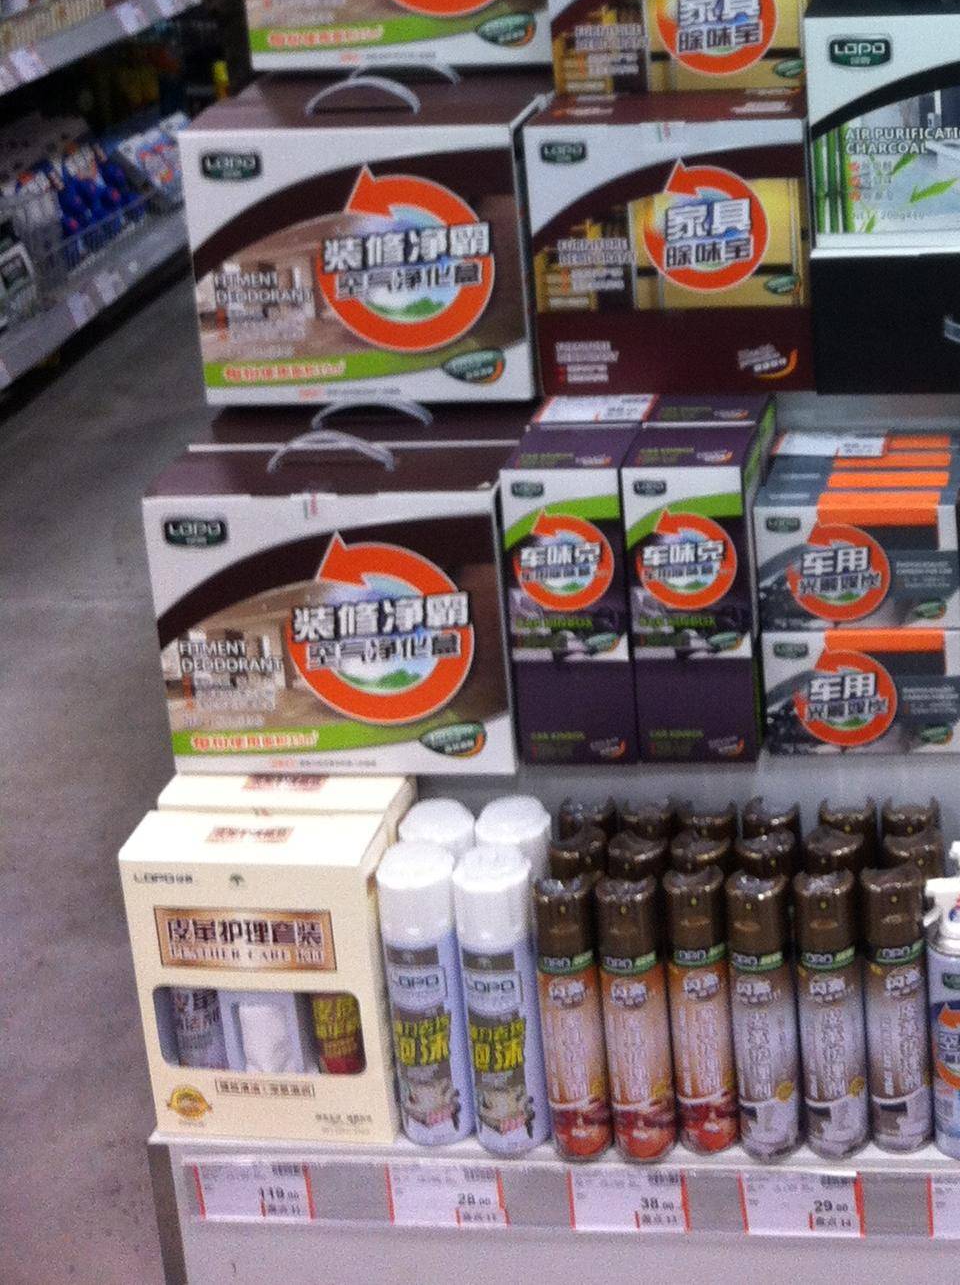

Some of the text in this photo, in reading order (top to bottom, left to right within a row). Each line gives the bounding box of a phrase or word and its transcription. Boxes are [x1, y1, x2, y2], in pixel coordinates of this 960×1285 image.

[677, 22, 762, 54] 除味宝
[834, 41, 886, 56] LOPO
[845, 128, 871, 141] AIR
[845, 142, 928, 155] CHARCOAL
[666, 199, 751, 239] 家具
[665, 237, 753, 268] 除味宝
[643, 540, 726, 567] 车味克
[803, 547, 869, 575] 车用
[294, 590, 469, 643] 装修净霸
[179, 640, 247, 656] FITMENT
[179, 656, 284, 674] DEODORANT
[811, 673, 877, 701] 车用
[167, 919, 324, 946] 皮革护理套装
